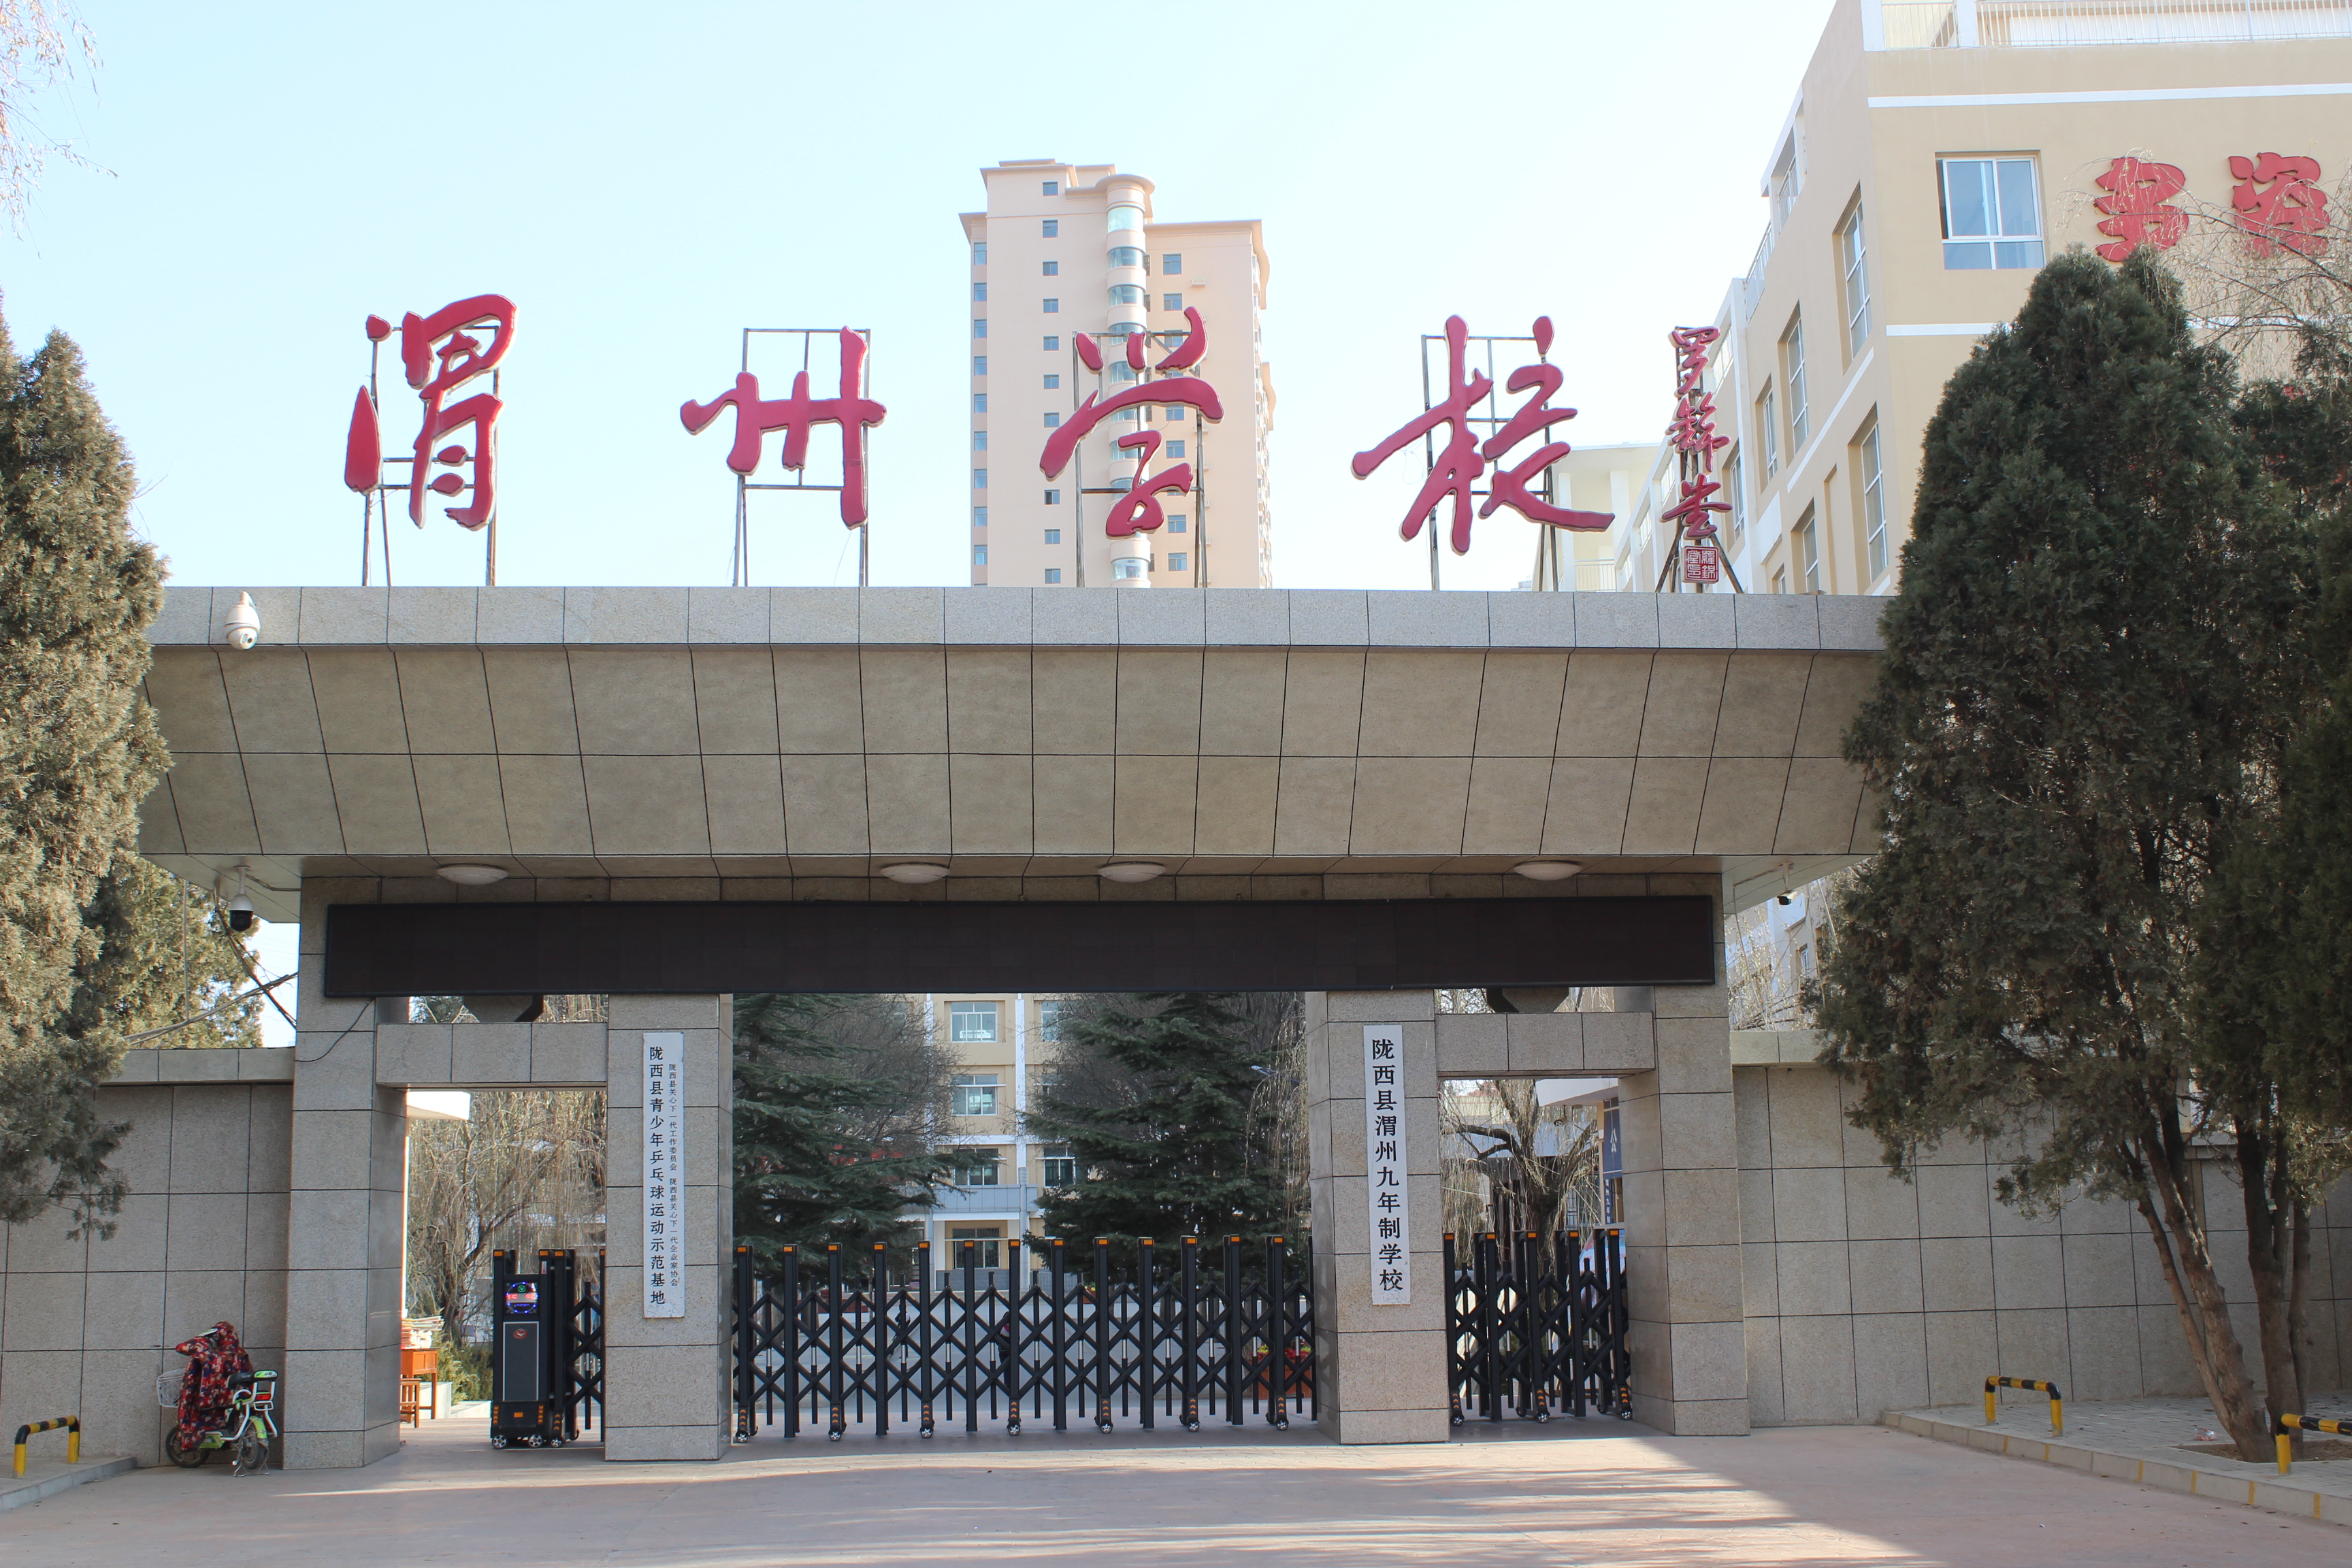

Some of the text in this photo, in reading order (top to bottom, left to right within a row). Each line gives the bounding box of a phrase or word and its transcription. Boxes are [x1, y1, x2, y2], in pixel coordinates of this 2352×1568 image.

[344, 293, 1615, 556] 渭州学校
[649, 1046, 665, 1305] 陇西县青少年乒乓球运动示范基地
[669, 1064, 677, 1171] 陇西县关心下一代工作委员会
[670, 1178, 679, 1286] 陇西县关心下一代企业家协会
[1372, 1039, 1403, 1291] 陇西县渭州九年制学校
